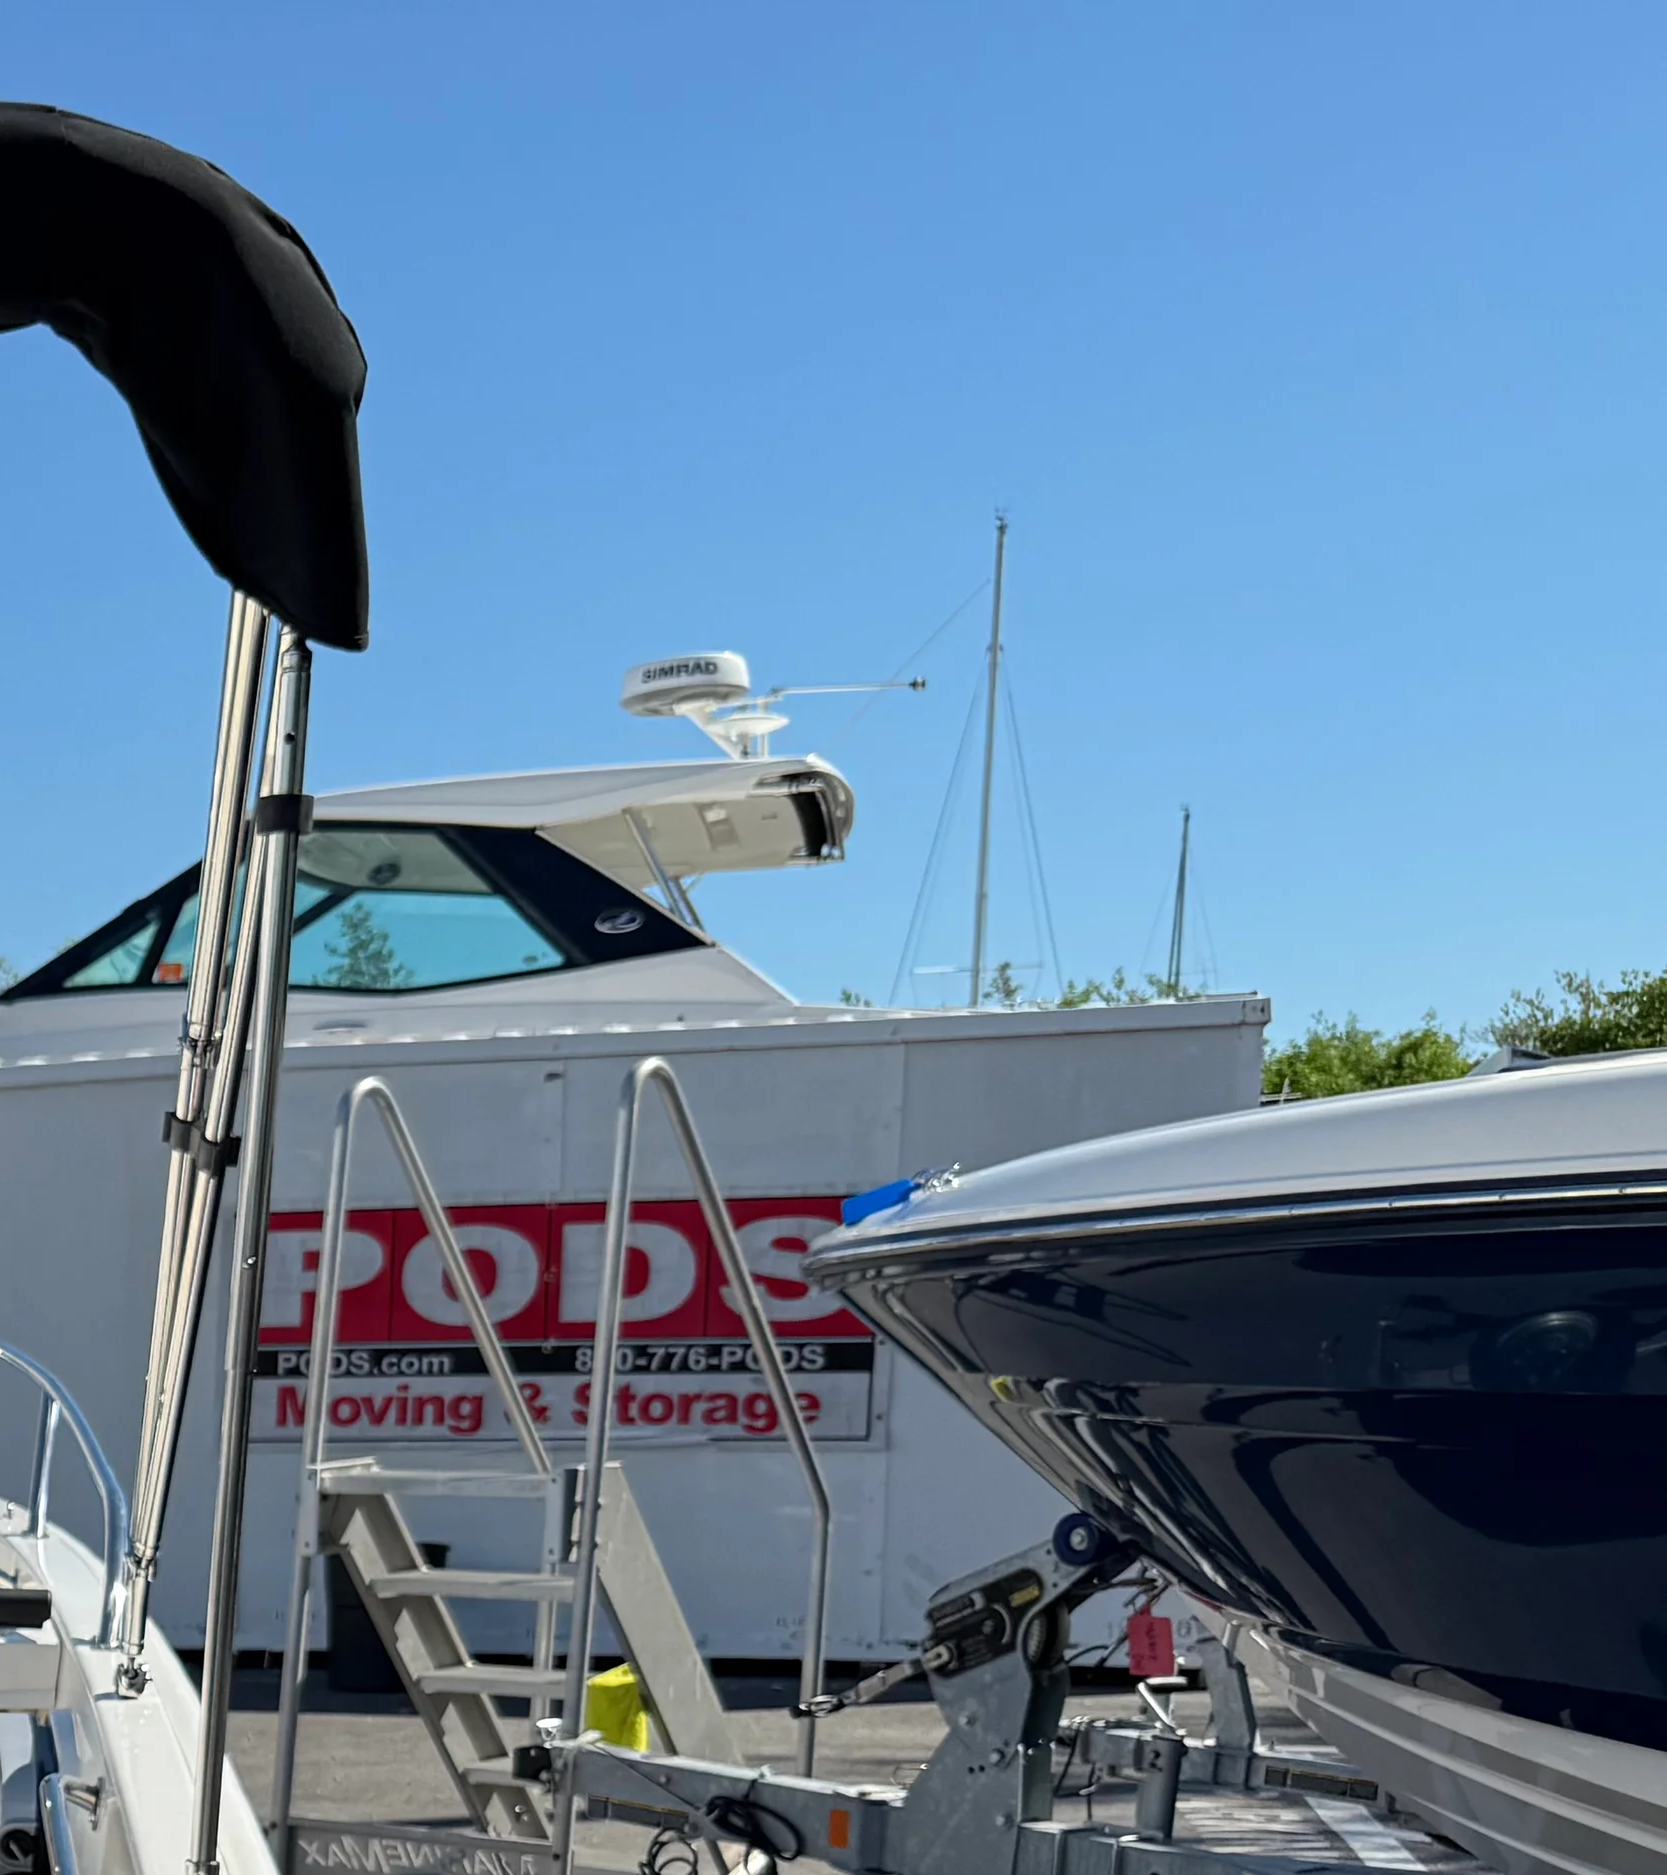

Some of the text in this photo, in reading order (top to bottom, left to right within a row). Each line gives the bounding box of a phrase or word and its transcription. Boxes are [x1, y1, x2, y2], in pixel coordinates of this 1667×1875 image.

[641, 661, 719, 684] SIMRAD
[259, 1215, 847, 1328] PODS
[575, 1345, 826, 1372] 80-776-PODS
[275, 1379, 822, 1436] Moving & Storage
